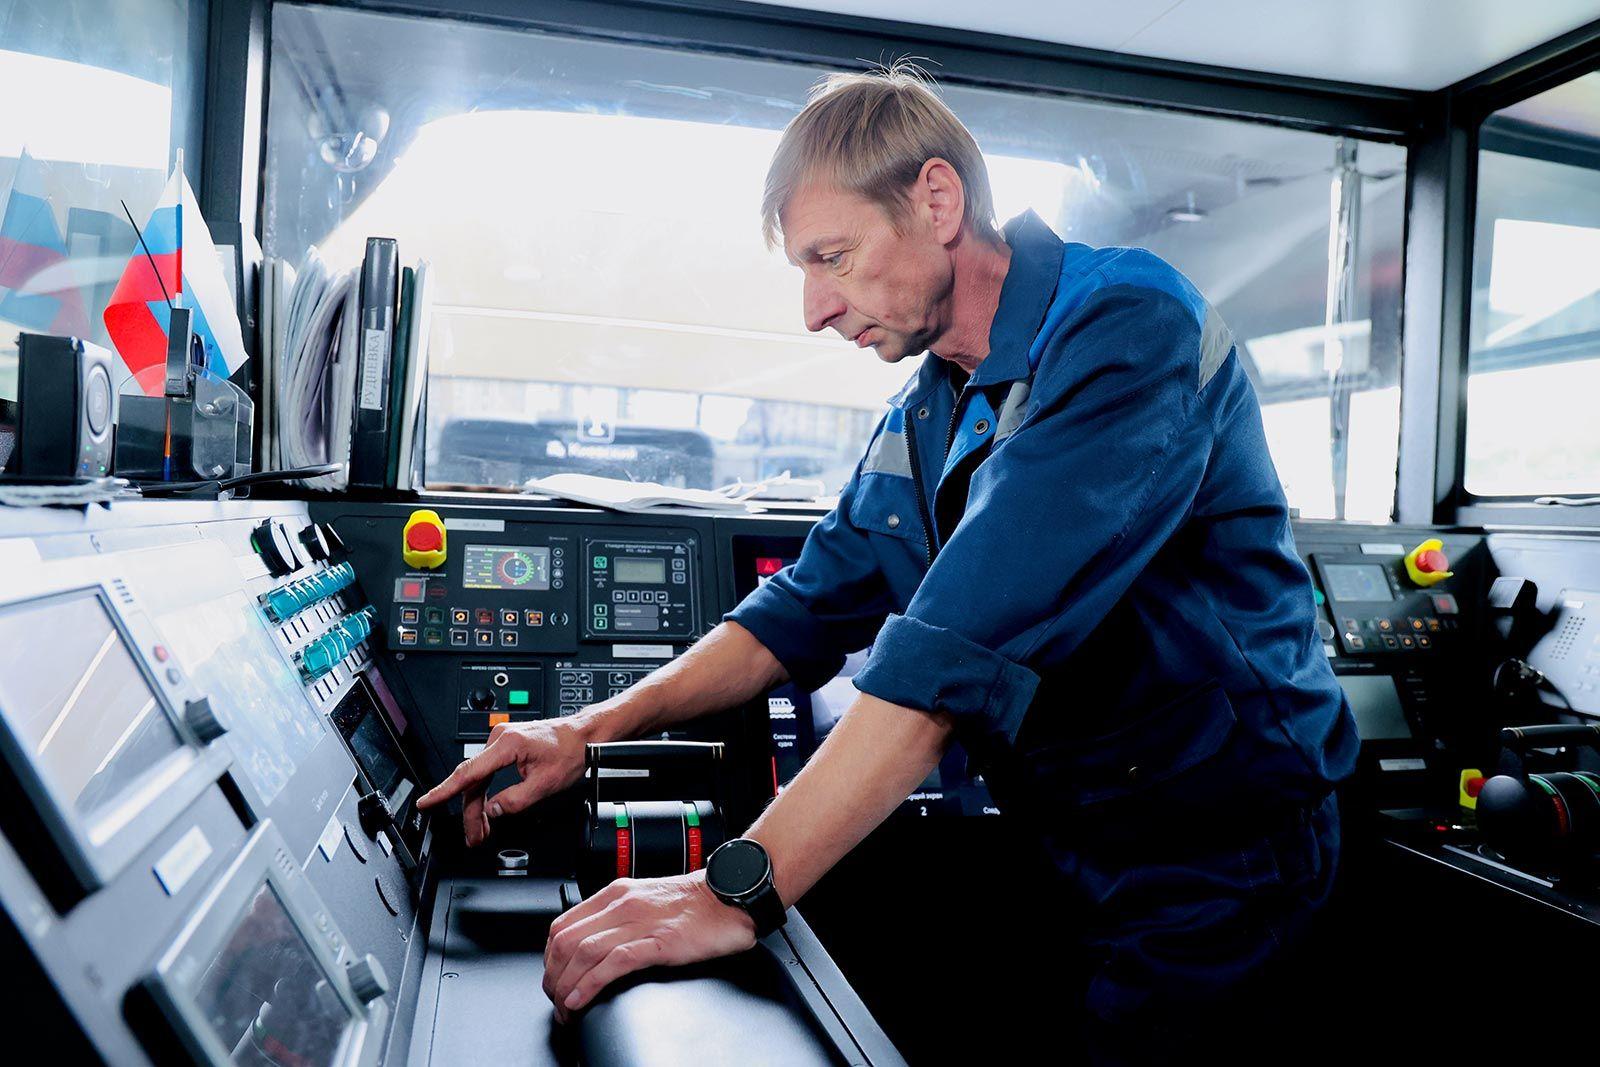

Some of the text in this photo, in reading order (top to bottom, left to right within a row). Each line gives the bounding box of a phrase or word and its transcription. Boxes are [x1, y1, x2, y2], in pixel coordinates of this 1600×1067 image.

[364, 333, 381, 406] РУДНЕВКА
[926, 793, 943, 801] экран
[920, 806, 927, 816] 2
